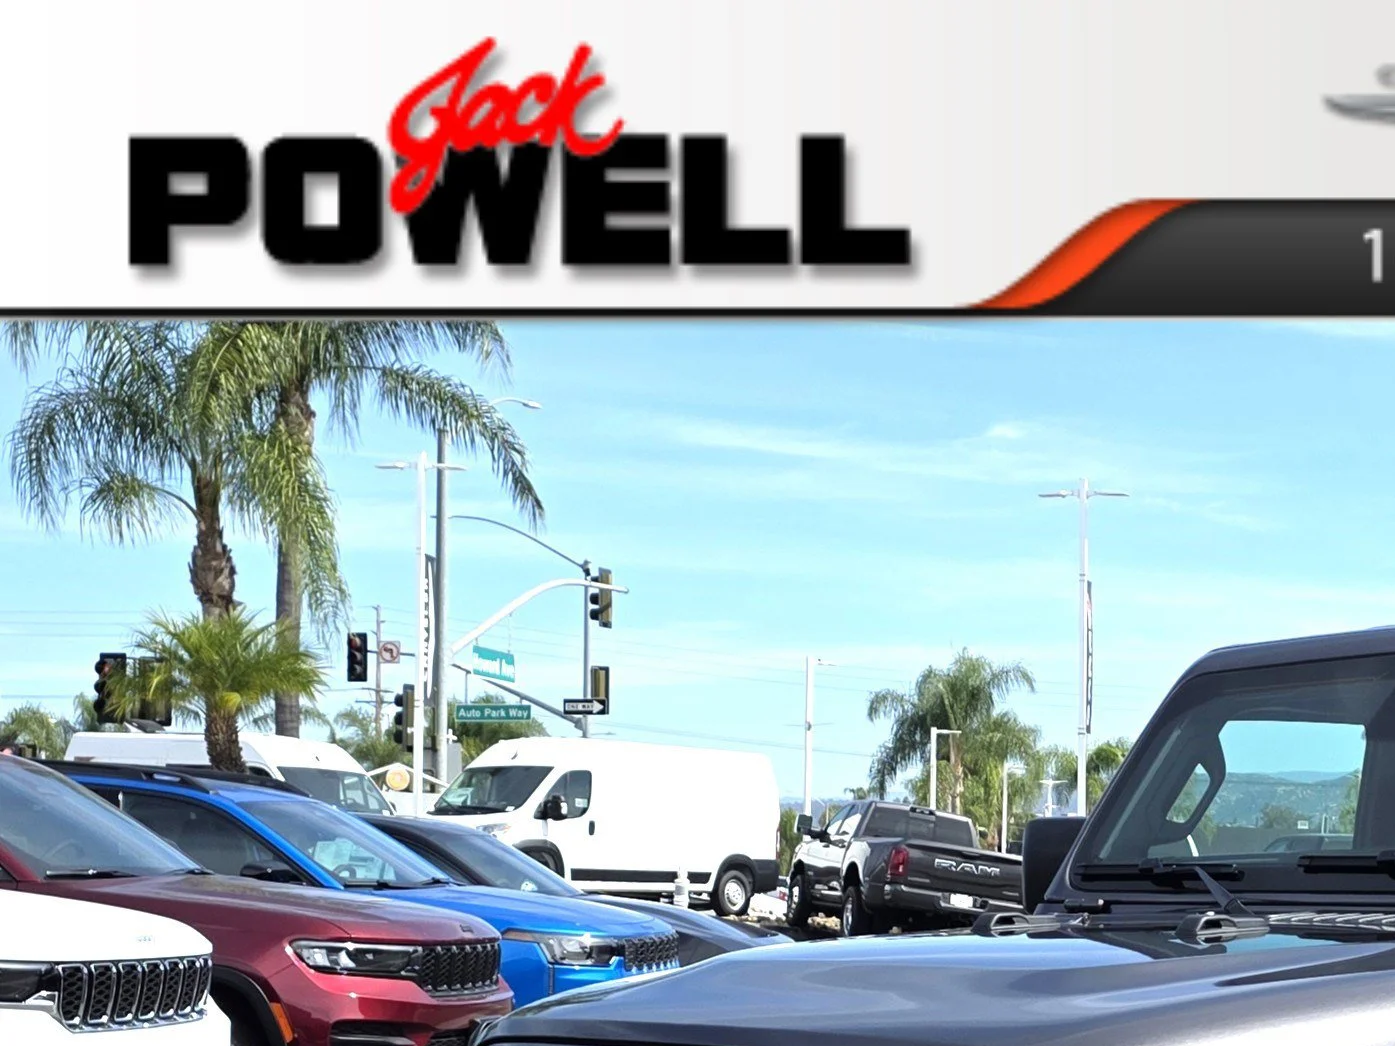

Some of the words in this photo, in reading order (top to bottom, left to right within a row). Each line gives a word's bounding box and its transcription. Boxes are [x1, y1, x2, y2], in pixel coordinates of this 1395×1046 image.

[458, 707, 481, 718] Auto
[484, 707, 506, 718] Park
[508, 707, 529, 720] Way
[934, 858, 1000, 877] RAM
